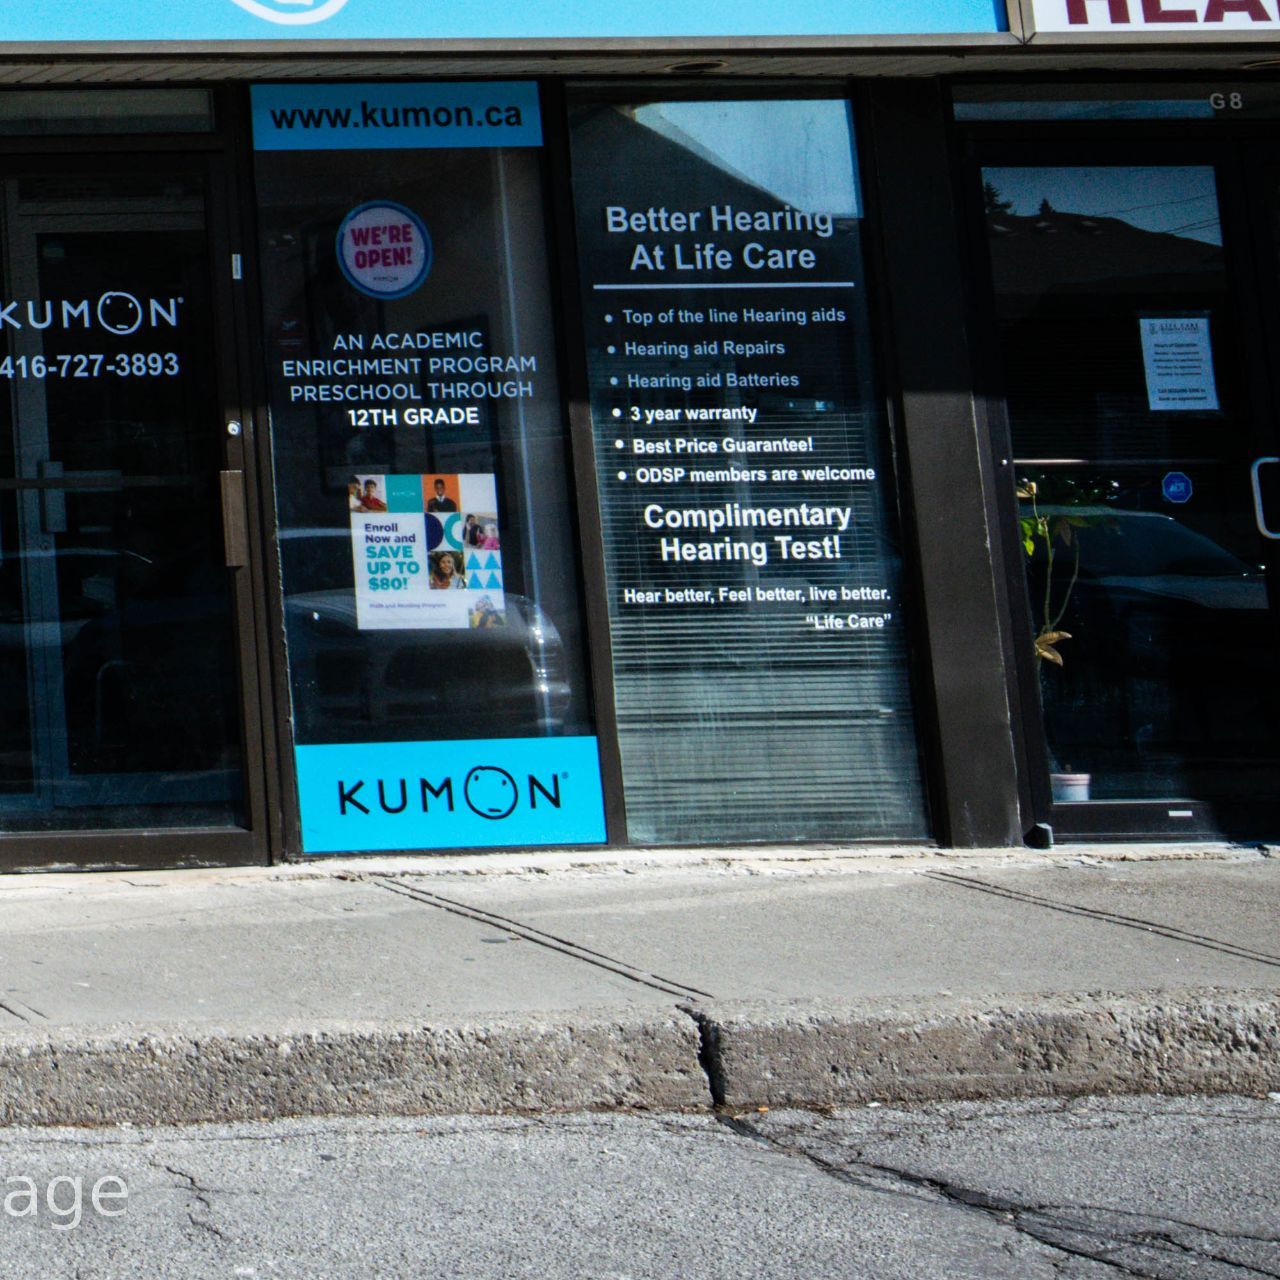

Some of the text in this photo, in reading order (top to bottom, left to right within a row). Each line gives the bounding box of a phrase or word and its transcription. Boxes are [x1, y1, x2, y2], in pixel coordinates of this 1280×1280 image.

[270, 99, 523, 129] www.kumon.ca
[606, 205, 834, 238] Better Hearing
[350, 223, 413, 247] WE'RE
[355, 247, 413, 269] OPEN!
[630, 243, 817, 271] At Life Care
[622, 307, 847, 327] Top of the line Hearing aids
[332, 332, 484, 351] AN ACADEMIC
[624, 340, 786, 360] Hearing aid Repairs
[282, 355, 538, 376] ENRICHMENT PROGRAM
[290, 380, 534, 402] PRESCHOOL THROUGH
[627, 372, 800, 392] Hearing aid Batteries
[347, 406, 480, 427] 12TH GRADE
[631, 406, 758, 424] 3 year warranty
[633, 437, 813, 454] Best Price Guarantee!
[636, 466, 876, 483] ODSP members are welcome
[365, 523, 398, 532] Enroll
[644, 503, 852, 533] Complimentary
[366, 533, 416, 543] Now and
[366, 545, 414, 559] SAVE
[661, 535, 842, 566] Hearing Test!
[367, 561, 420, 575] UP TO
[368, 577, 408, 591] $80!
[624, 586, 891, 605] Hear better, Feel better, live better.
[339, 765, 561, 821] KUMON
